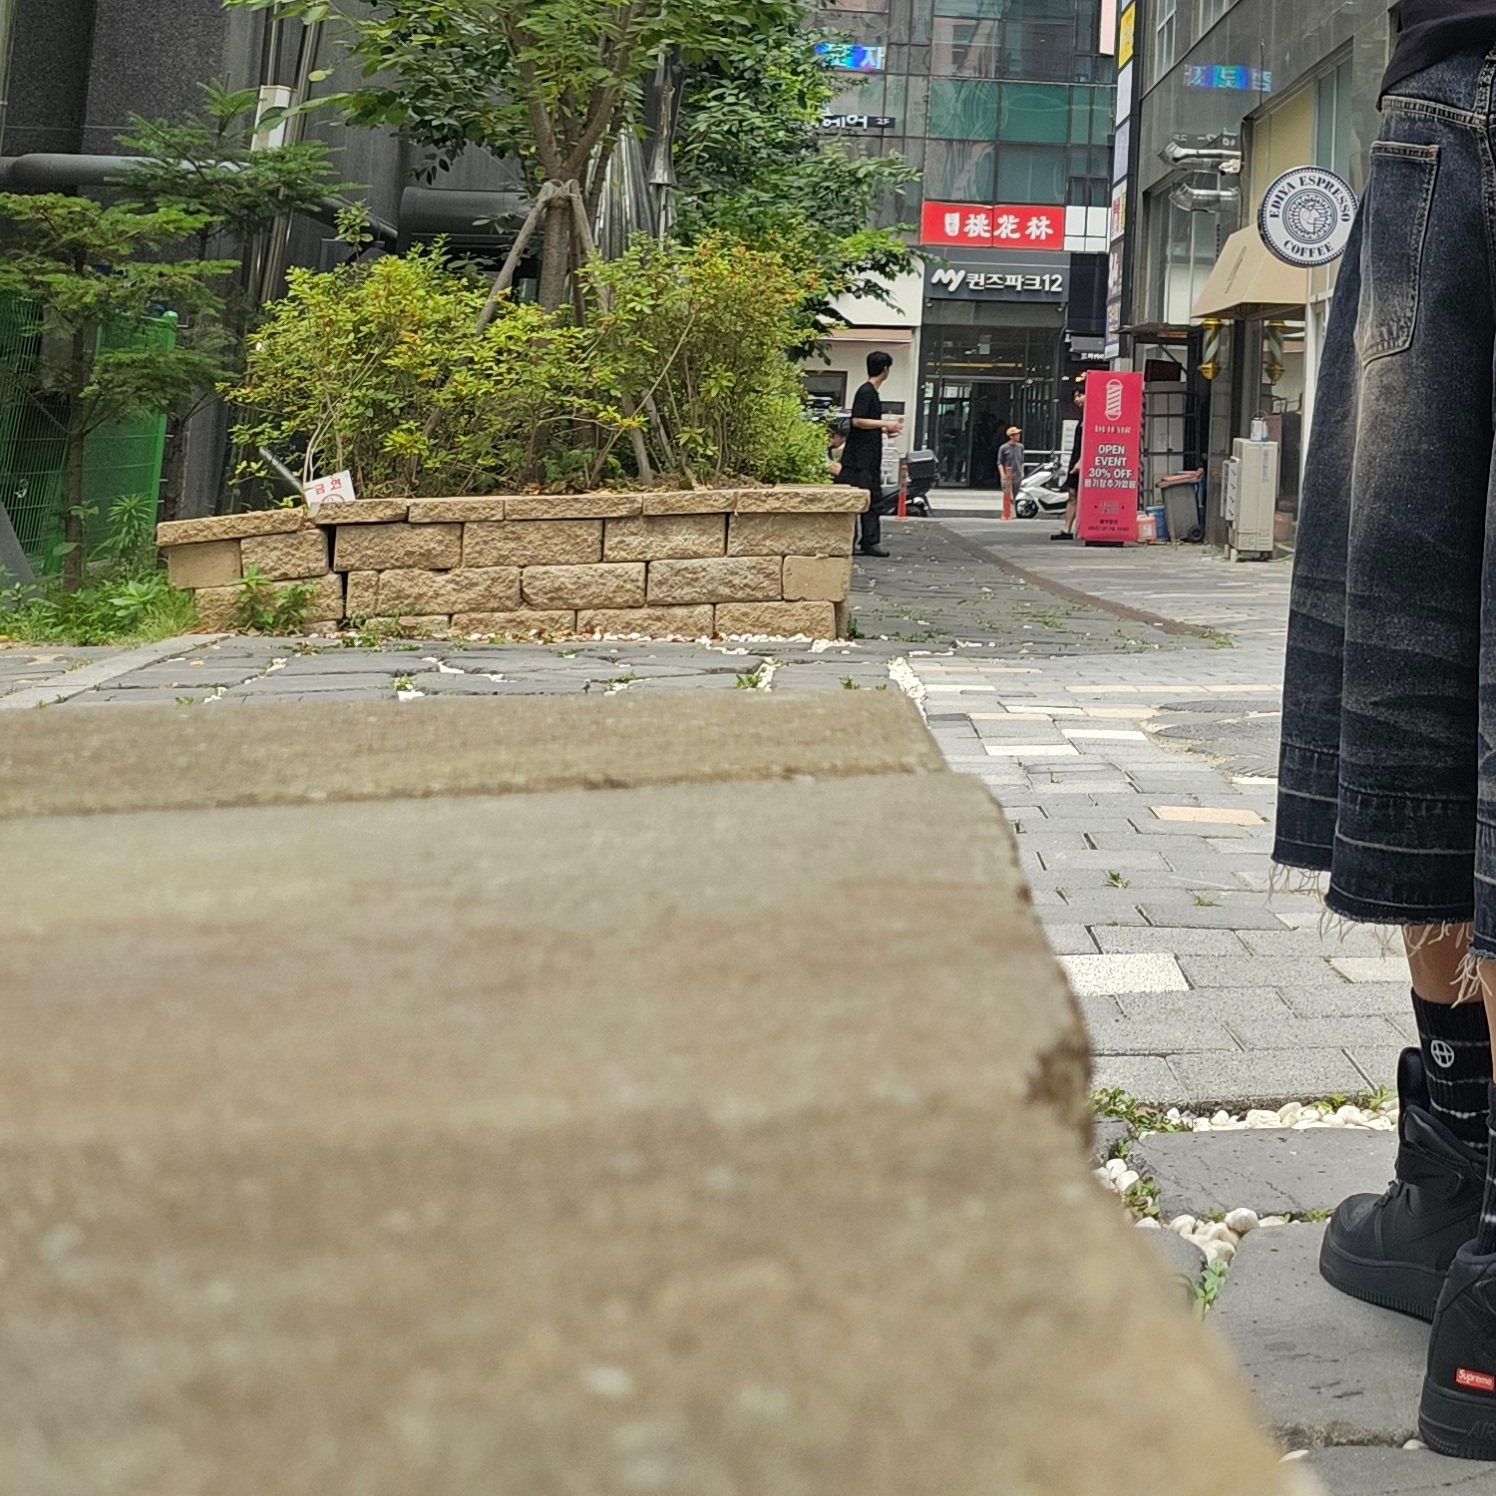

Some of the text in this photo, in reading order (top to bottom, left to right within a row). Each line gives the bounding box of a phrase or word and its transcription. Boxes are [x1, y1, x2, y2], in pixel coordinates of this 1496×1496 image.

[1269, 175, 1351, 223] EDIYA ESPRESSO
[963, 212, 1054, 241] 桃花林
[1283, 239, 1335, 259] COFFEE
[965, 272, 1064, 293] 퀸즈파크12
[1098, 444, 1126, 455] OPEN
[1094, 456, 1128, 467] EVENT
[1088, 467, 1133, 479] 30% OFF
[1458, 1369, 1494, 1387] Supreme
[1467, 1420, 1496, 1441] AIR
